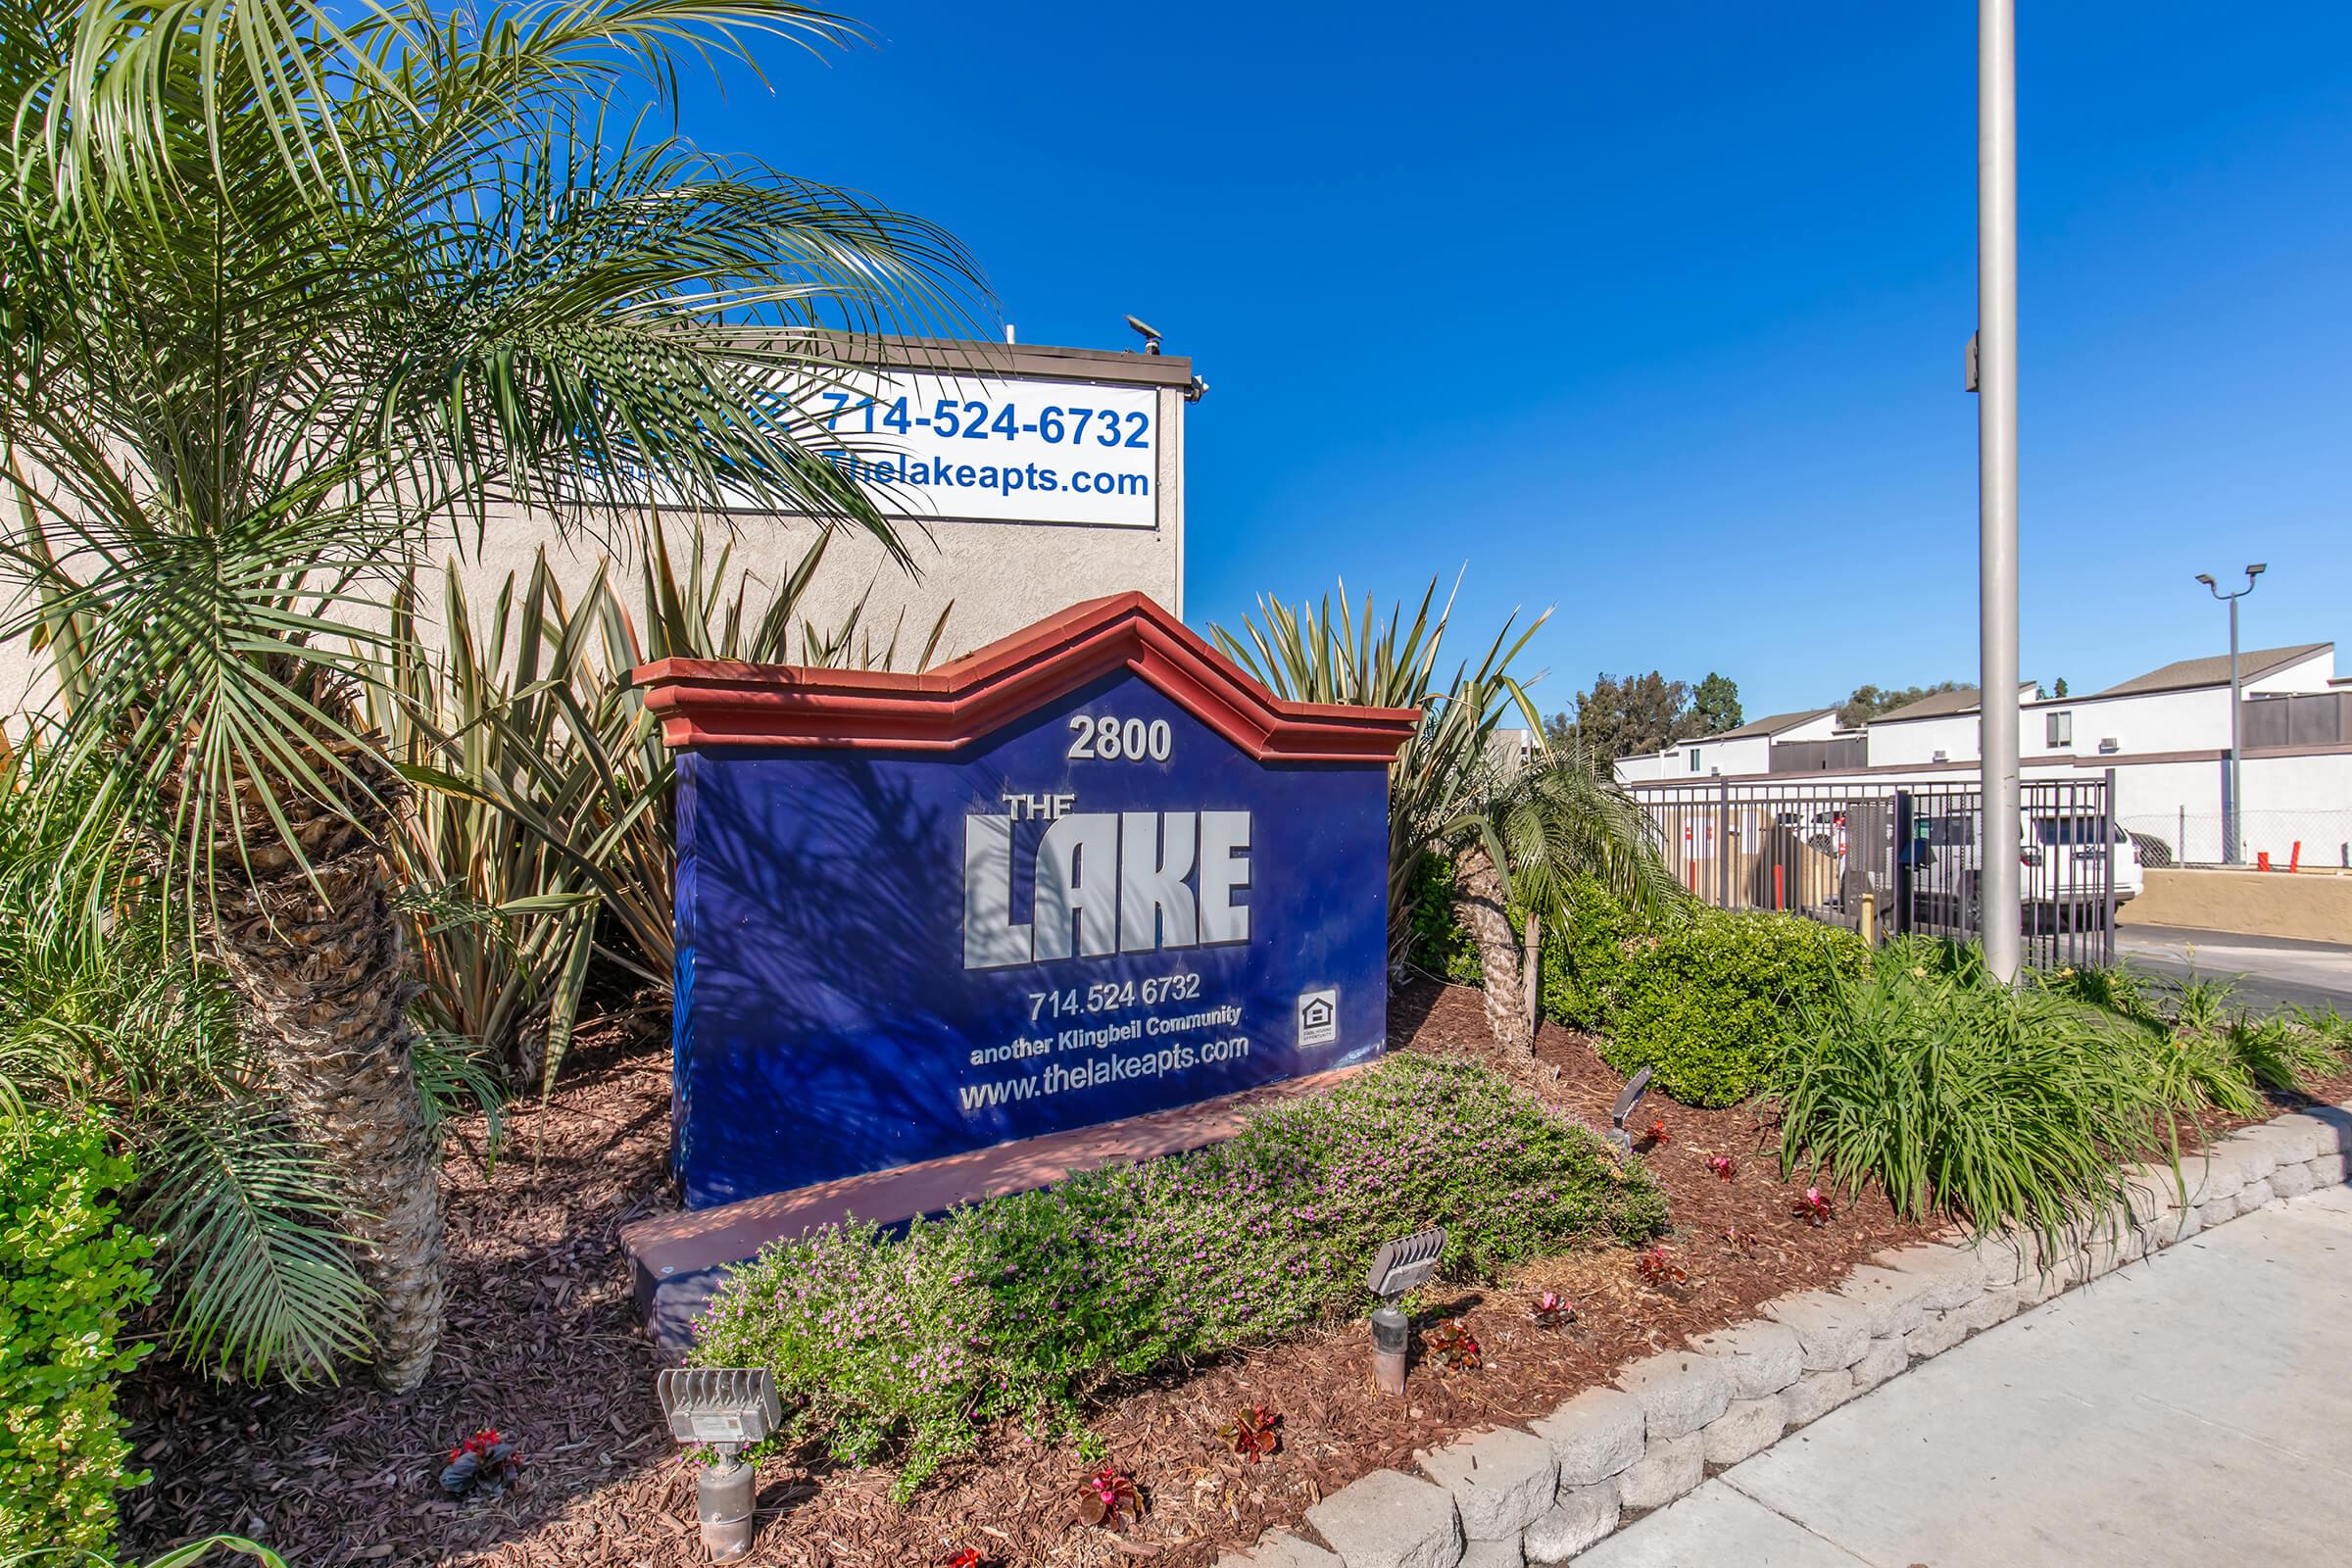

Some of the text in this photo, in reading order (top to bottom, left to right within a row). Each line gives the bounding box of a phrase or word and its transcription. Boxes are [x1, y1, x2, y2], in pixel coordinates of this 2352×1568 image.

[822, 392, 1150, 449] 714-524-6732
[1068, 714, 1172, 761] 2800
[1003, 793, 1076, 821] THE
[963, 810, 1251, 970] LAKE
[1029, 973, 1200, 1021] 714.524 6732
[970, 1004, 1243, 1066] another Klingbeil Community
[959, 1036, 1250, 1110] www.thelakeapts.com
